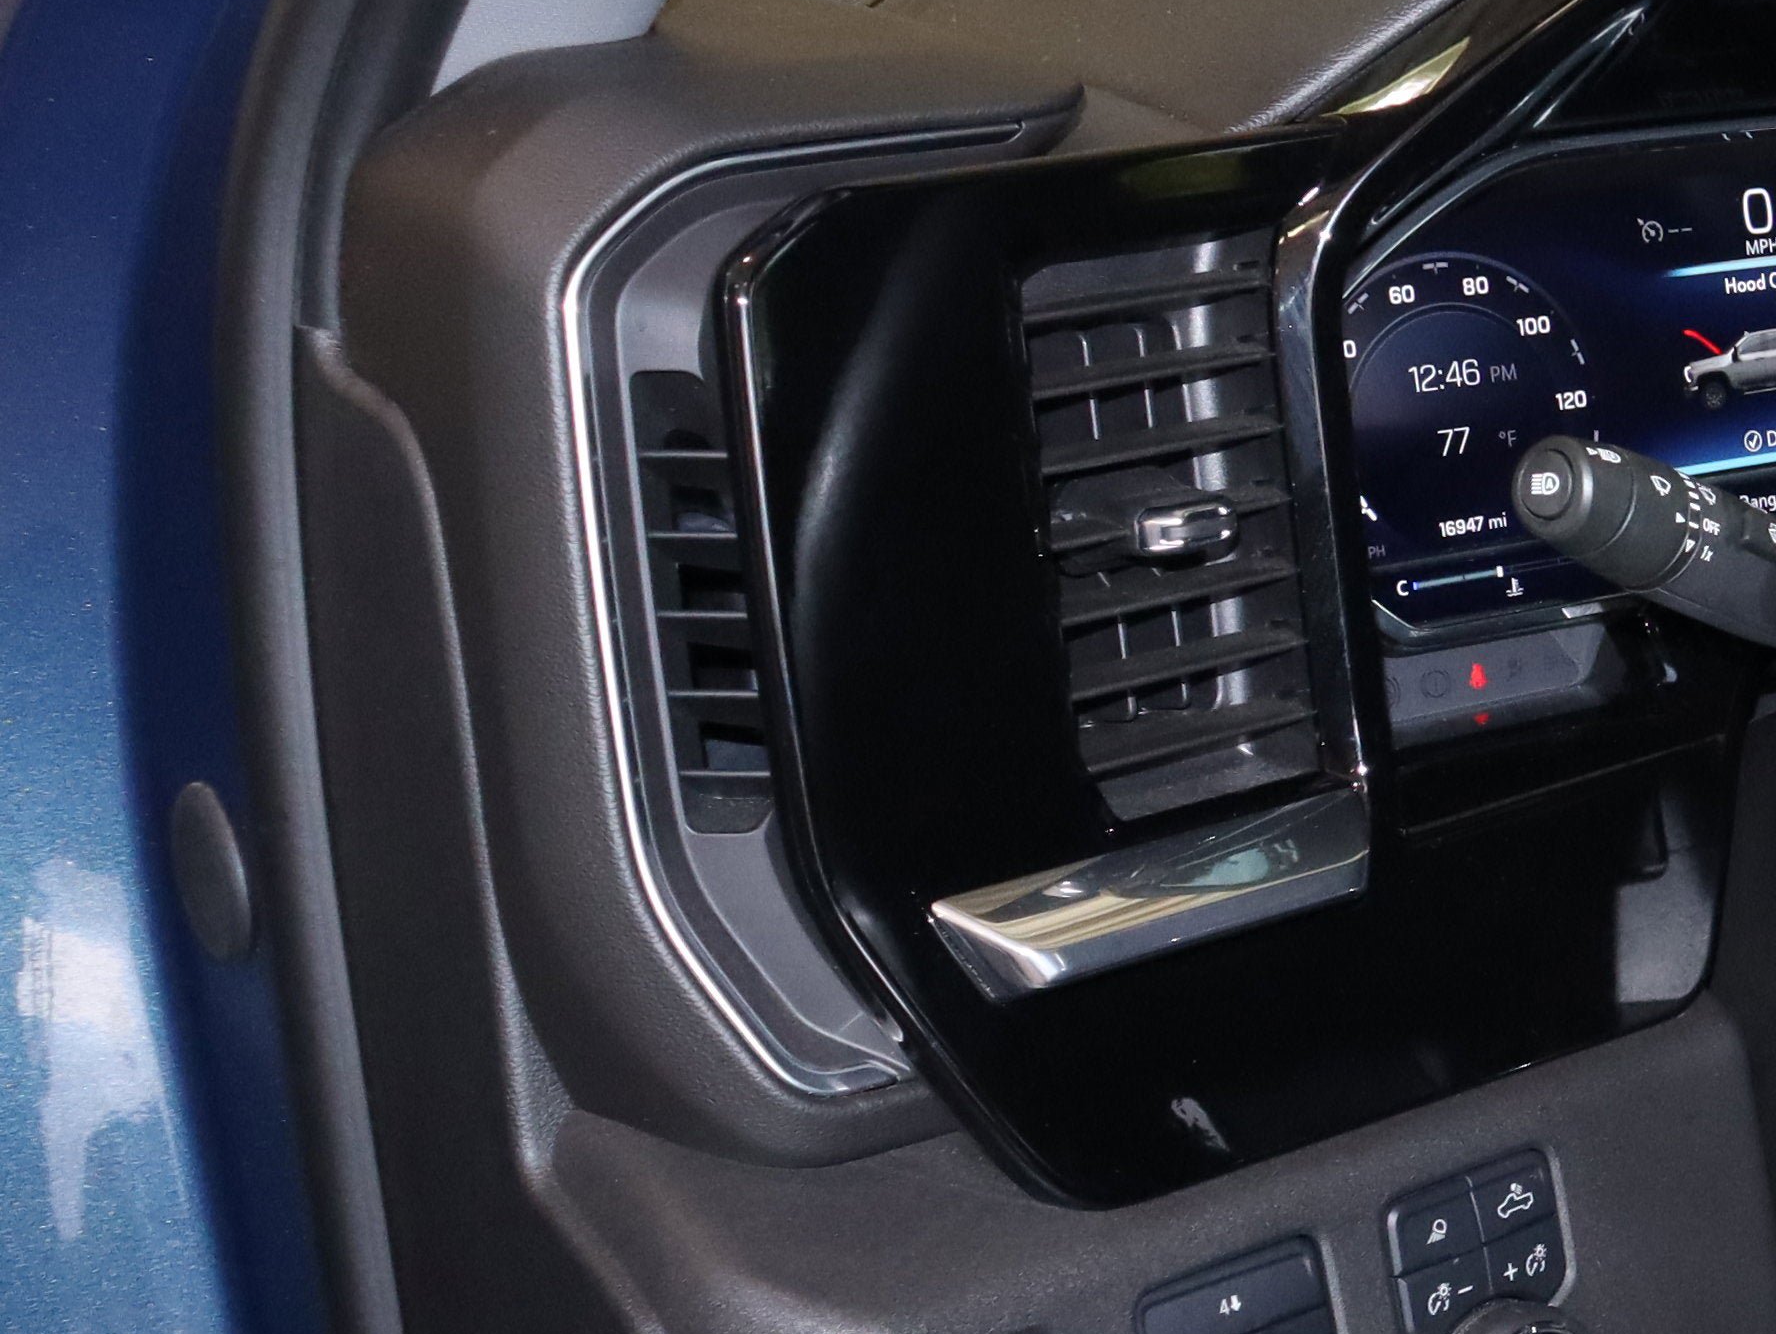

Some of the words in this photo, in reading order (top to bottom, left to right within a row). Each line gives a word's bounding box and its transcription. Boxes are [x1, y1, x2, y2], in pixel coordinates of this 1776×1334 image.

[1742, 187, 1773, 235] 0
[1388, 284, 1415, 304] 60
[1462, 275, 1490, 295] 80
[1724, 276, 1766, 294] Hood
[1516, 315, 1551, 336] 100
[1408, 359, 1481, 393] 12:46
[1489, 364, 1518, 383] PM
[1555, 390, 1587, 410] 120
[1437, 427, 1470, 457] 77
[1498, 430, 1517, 447] °F
[1439, 516, 1484, 537] 16947
[1489, 512, 1507, 529] mi
[1702, 517, 1721, 536] OFF
[1700, 544, 1714, 563] 1x
[1396, 580, 1409, 597] C
